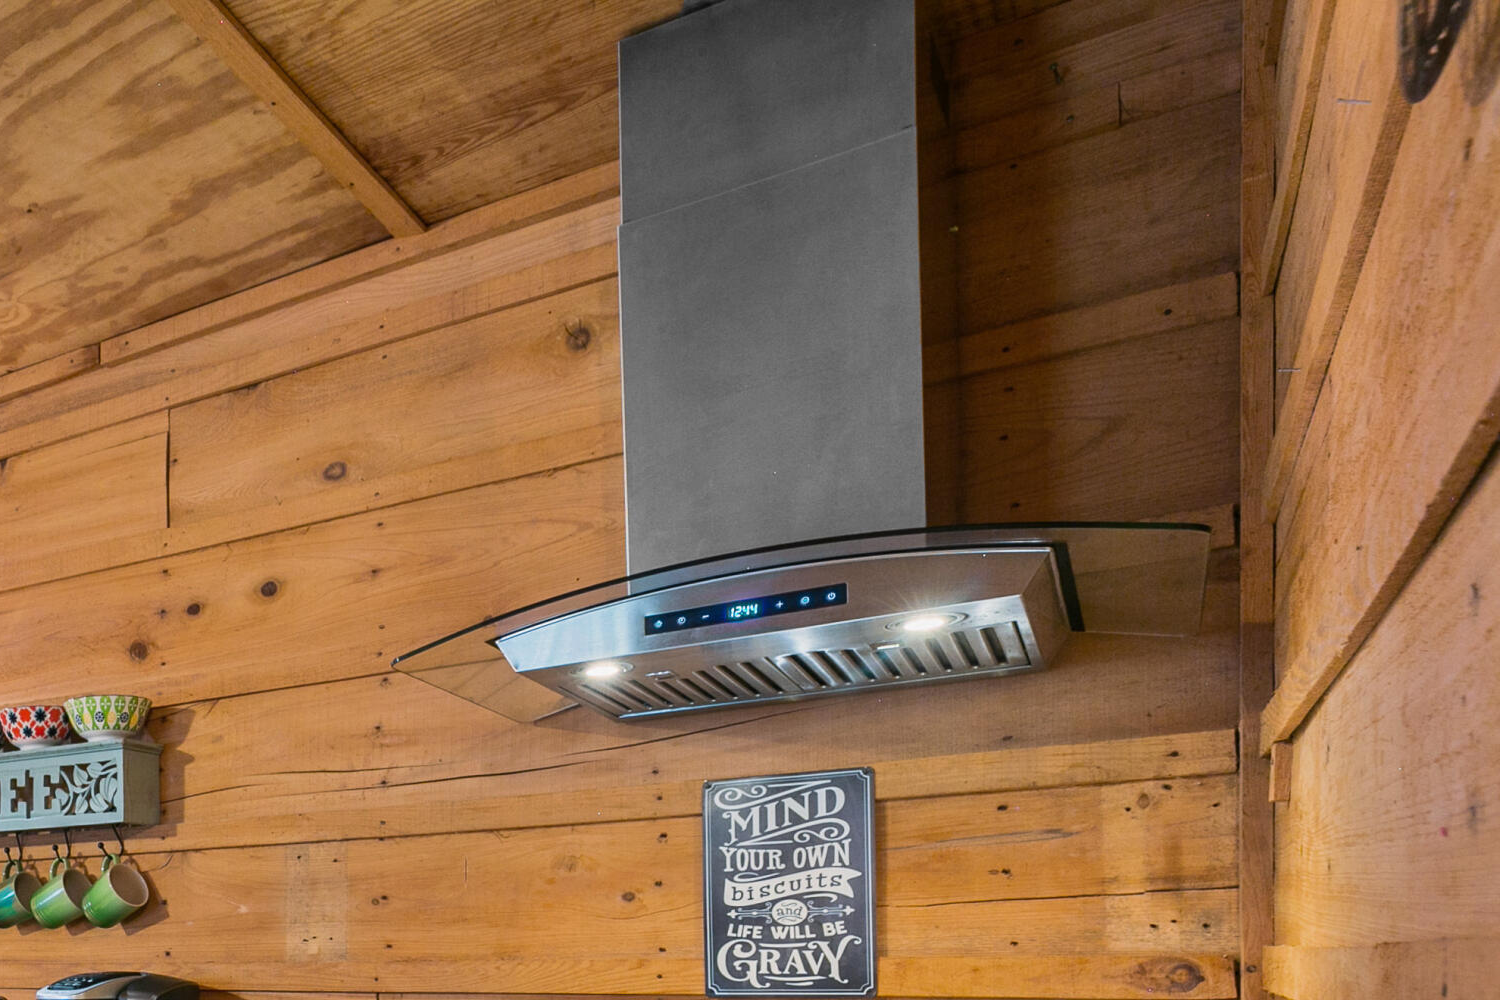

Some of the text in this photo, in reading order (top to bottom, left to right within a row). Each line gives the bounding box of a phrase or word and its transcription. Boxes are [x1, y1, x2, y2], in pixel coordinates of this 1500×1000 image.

[722, 786, 845, 847] MIND
[719, 838, 852, 872] YOUR OWN
[731, 874, 842, 901] biscuits
[776, 905, 803, 917] and
[727, 921, 848, 939] LIFE WILL BE
[717, 935, 862, 988] GRAVY
